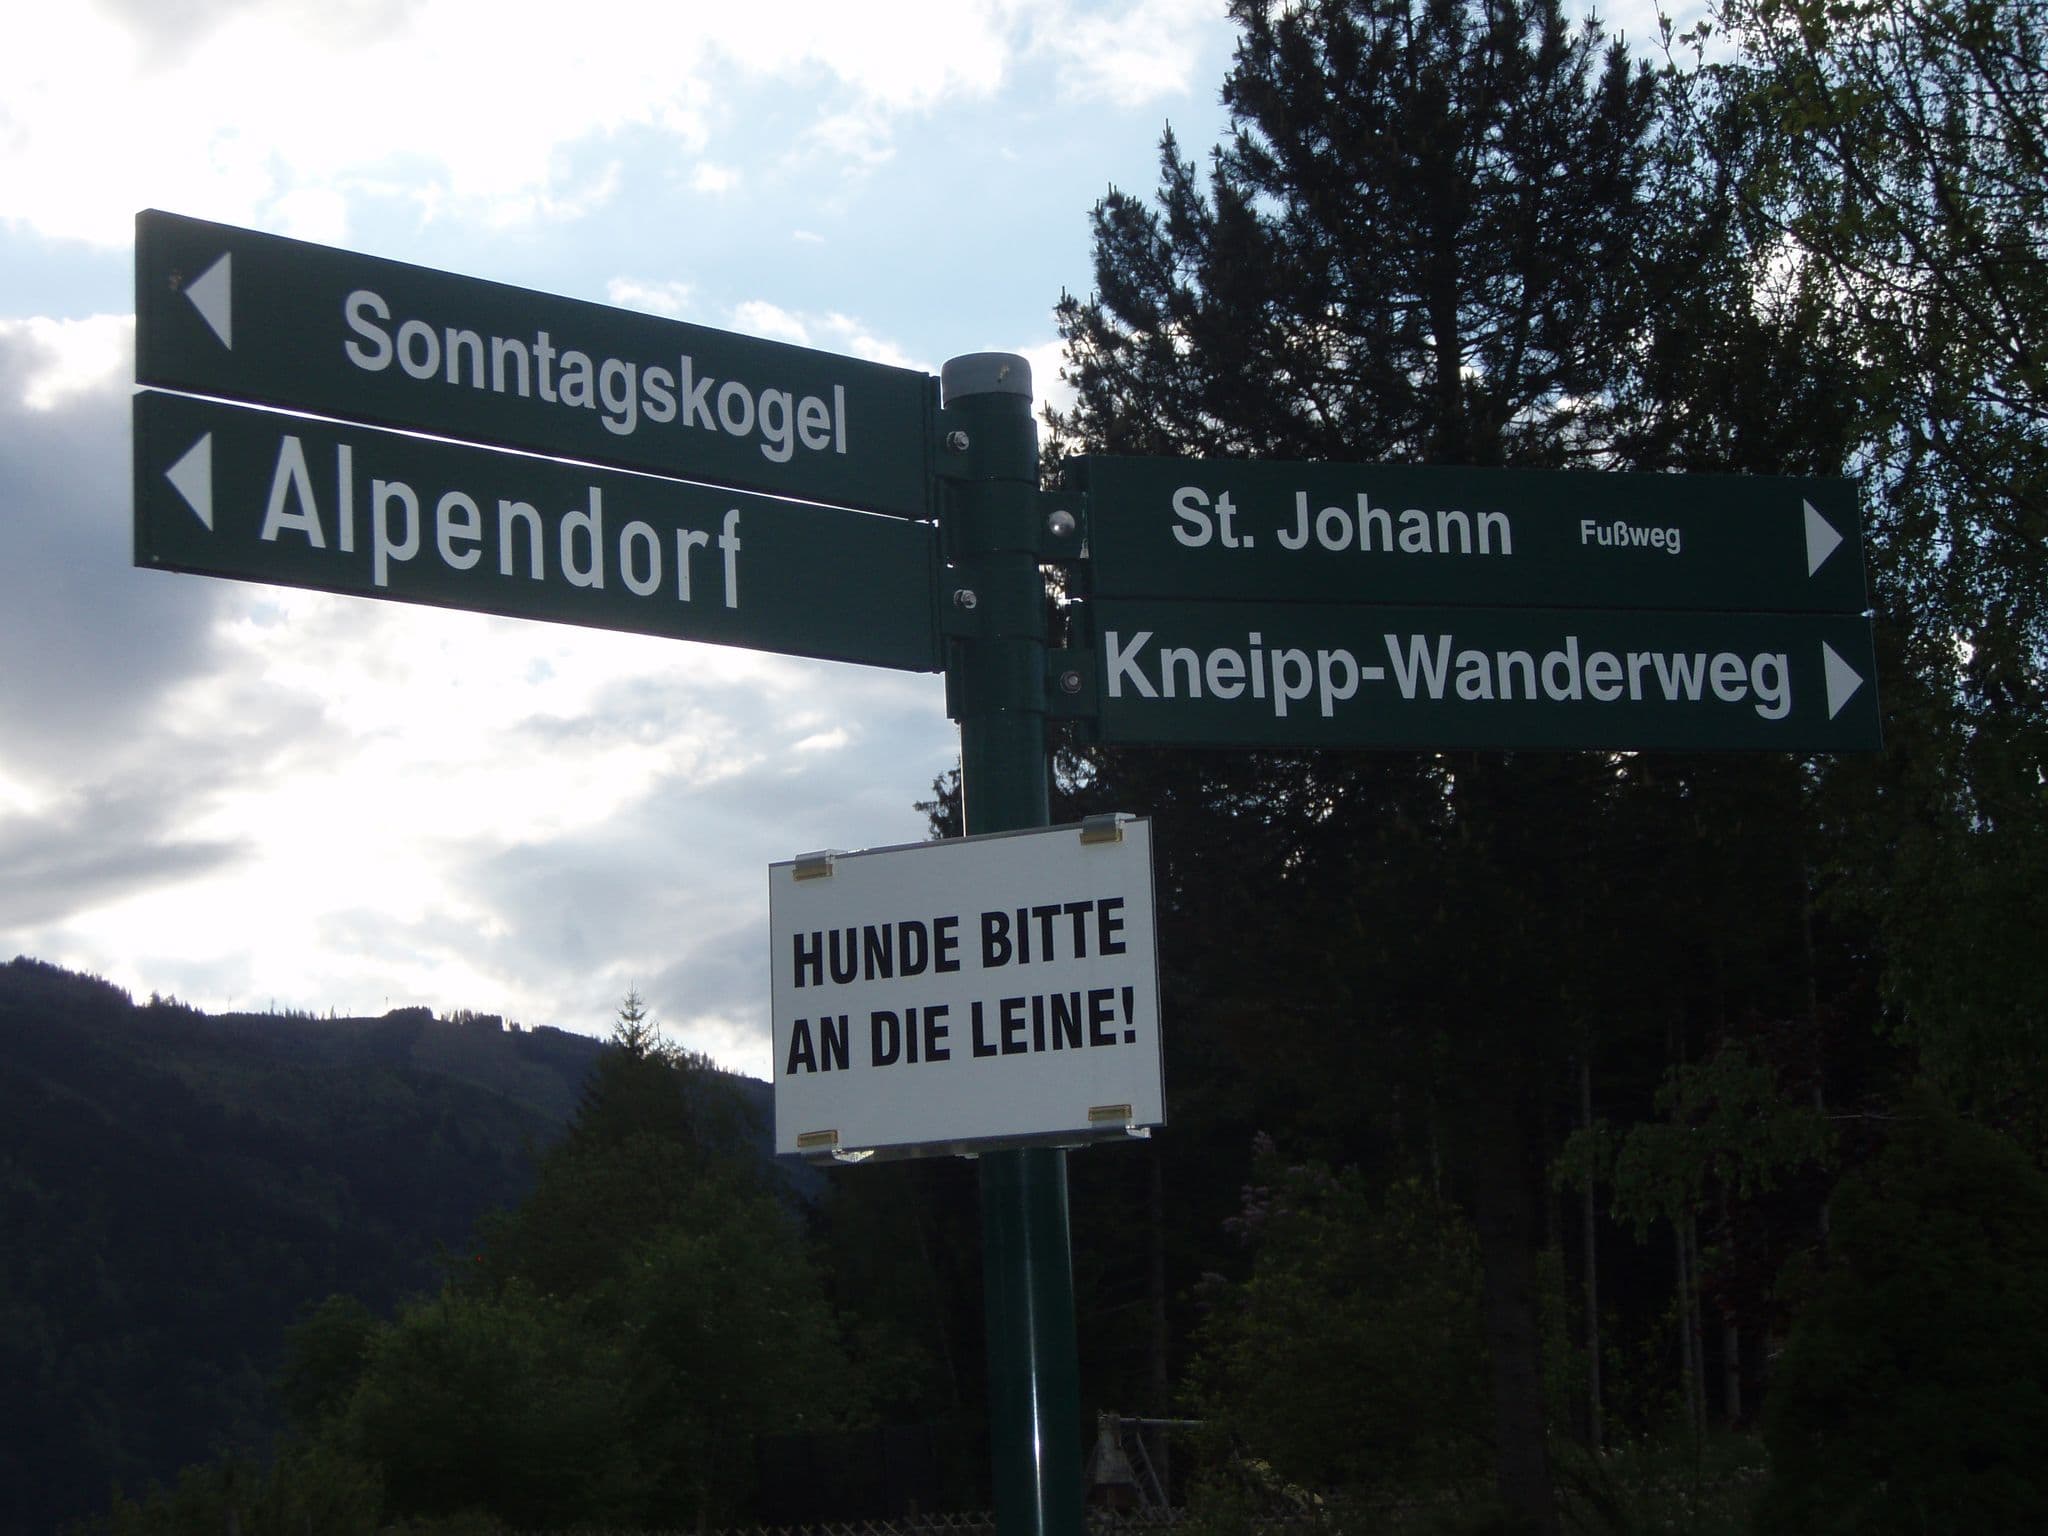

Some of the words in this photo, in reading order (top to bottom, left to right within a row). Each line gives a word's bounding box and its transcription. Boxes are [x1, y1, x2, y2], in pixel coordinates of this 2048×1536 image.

[344, 290, 847, 463] Sonntagskogel
[261, 434, 742, 609] Alpendorf
[1171, 486, 1255, 549] St.
[1276, 490, 1512, 555] Johann
[1580, 519, 1681, 555] Fußweg
[1104, 631, 1791, 720] Kneipp-Wanderweg
[793, 916, 961, 989] HUNDE
[980, 897, 1127, 969] BITTE
[786, 1015, 850, 1075] AN
[870, 1005, 951, 1068] DIE
[970, 986, 1137, 1058] LEINE!
